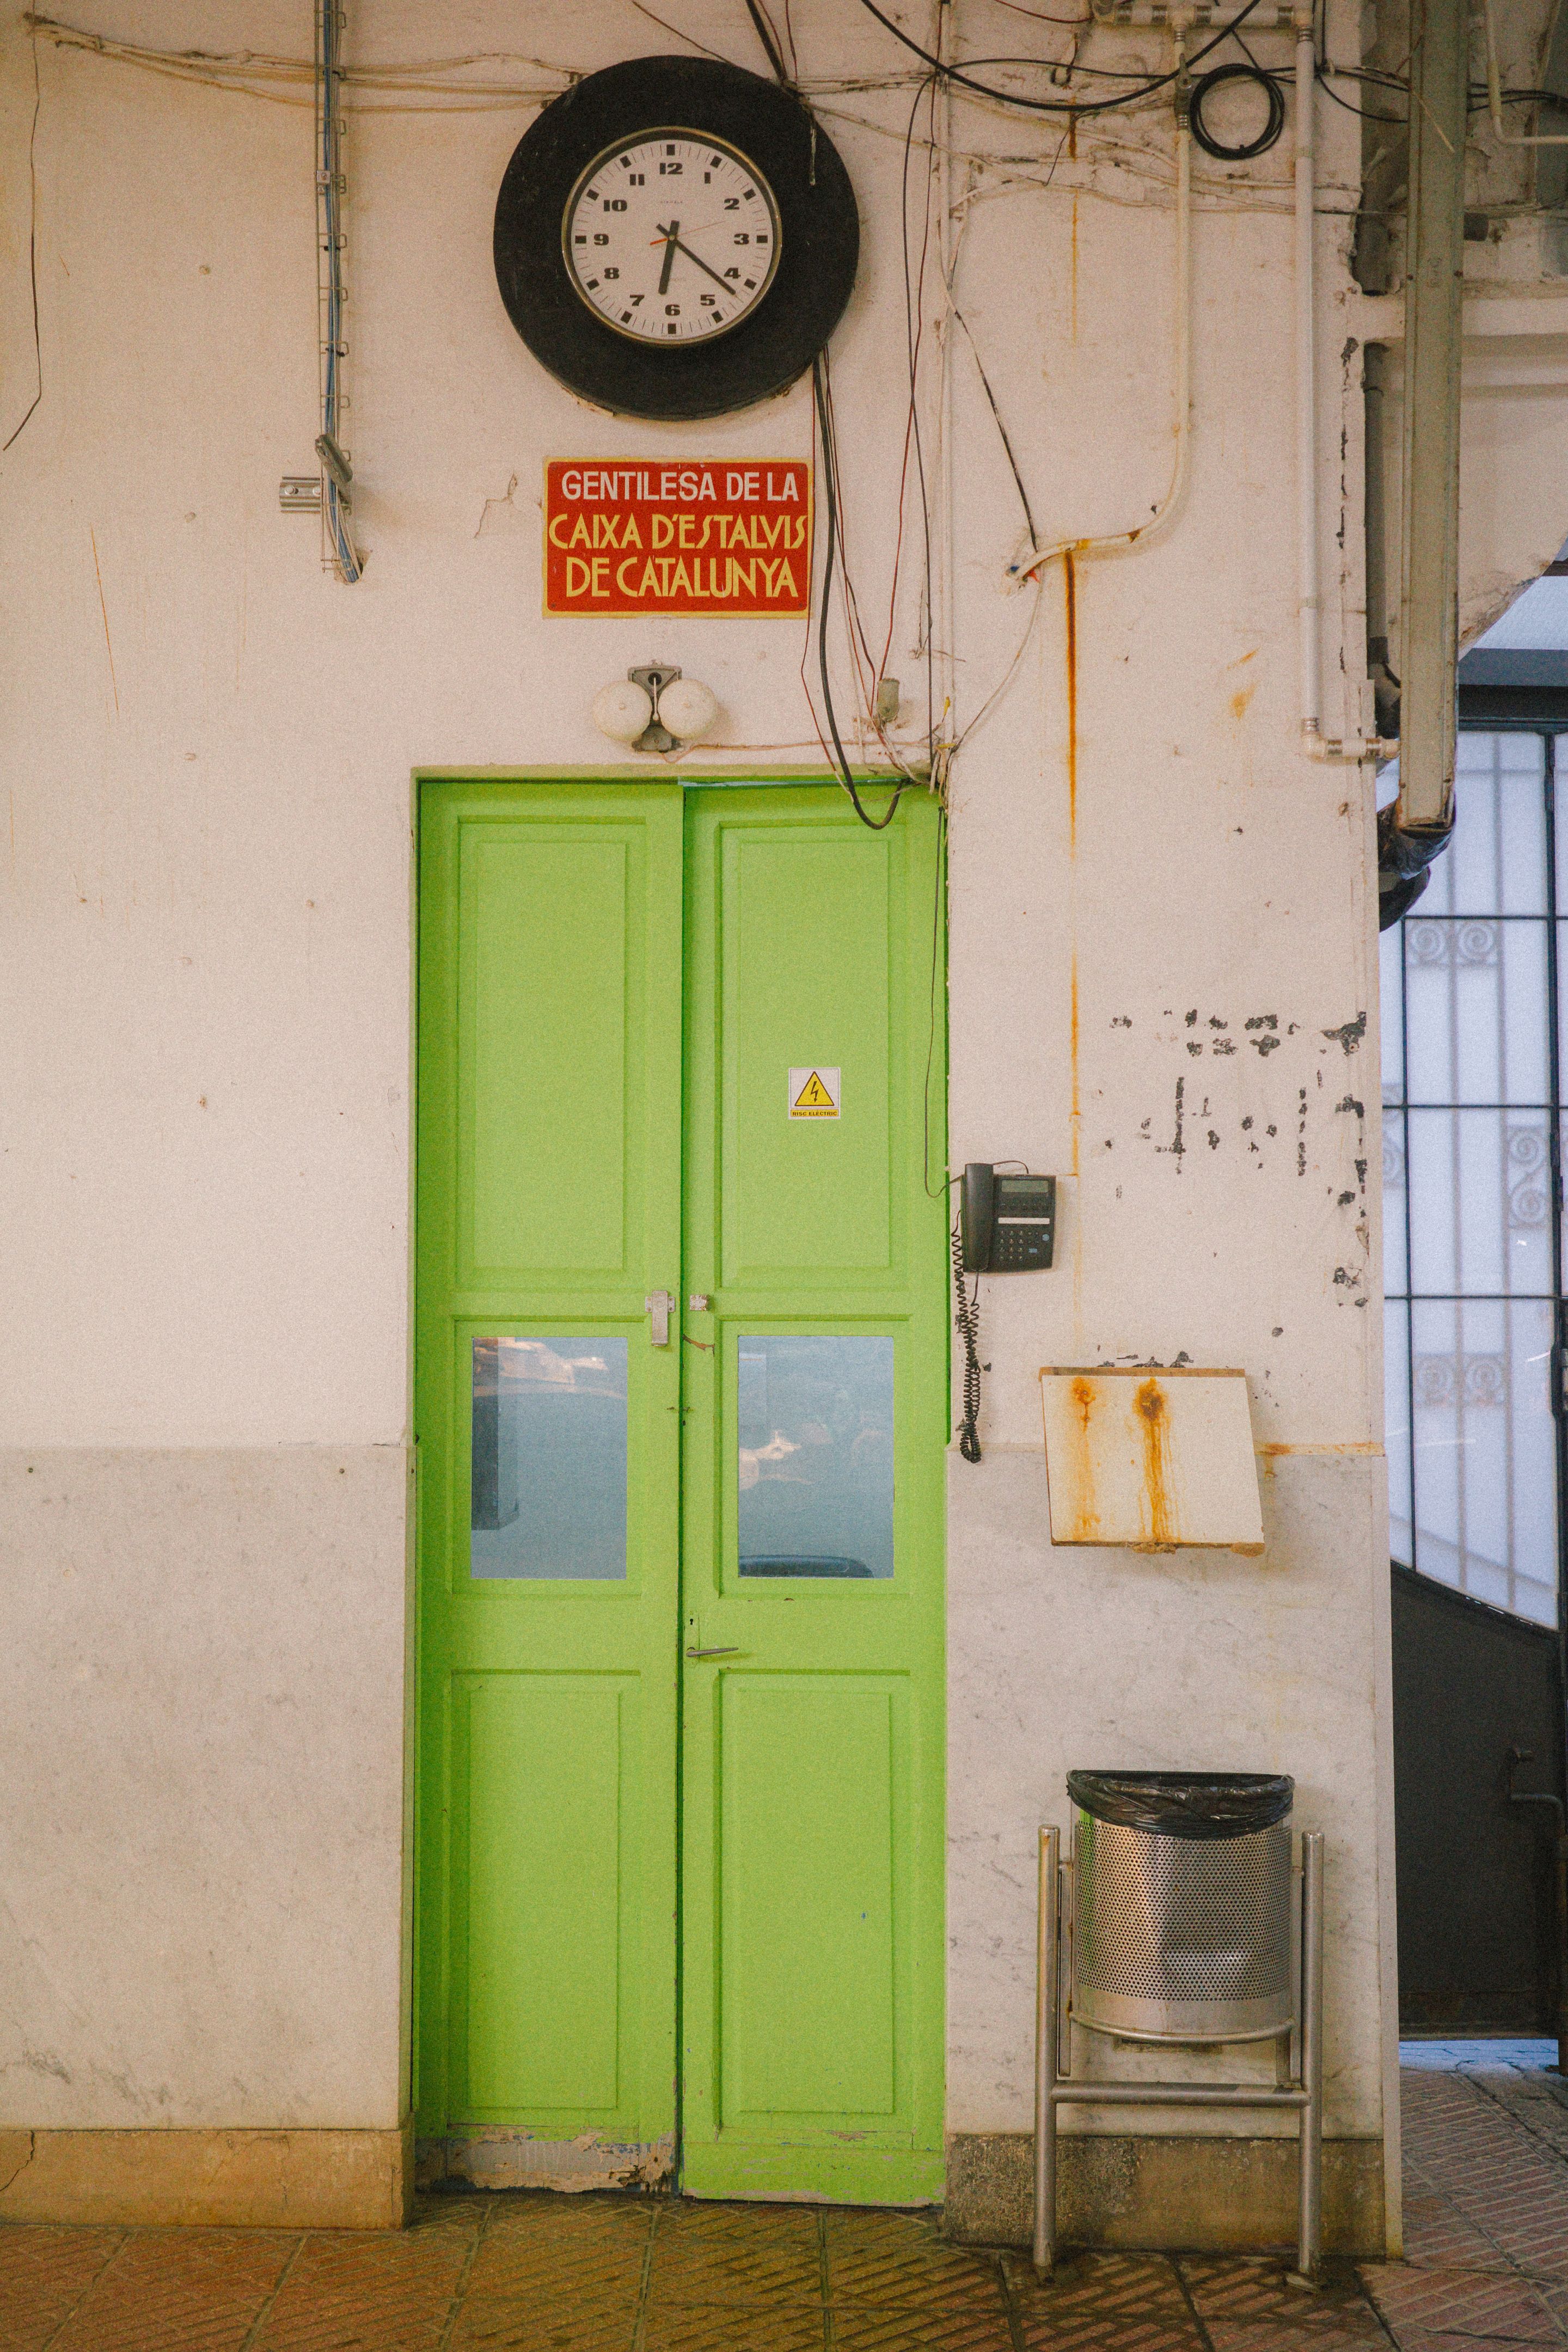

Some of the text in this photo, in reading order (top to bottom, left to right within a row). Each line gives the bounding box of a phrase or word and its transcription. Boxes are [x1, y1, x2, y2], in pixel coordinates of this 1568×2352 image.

[659, 162, 683, 175] 12
[629, 174, 645, 186] 11
[704, 171, 711, 184] 1
[603, 199, 628, 212] 10
[724, 198, 740, 210] 2
[593, 233, 609, 246] 9
[733, 233, 750, 246] 3
[604, 267, 620, 280] 8
[724, 267, 741, 279] 4
[629, 295, 645, 307] 7
[700, 294, 715, 306] 5
[665, 304, 681, 316] 6
[561, 470, 799, 501] GENTILESA DE LA
[548, 513, 807, 549] CAIXA D'ESTALVIS
[566, 556, 799, 598] DE CATALUNYA
